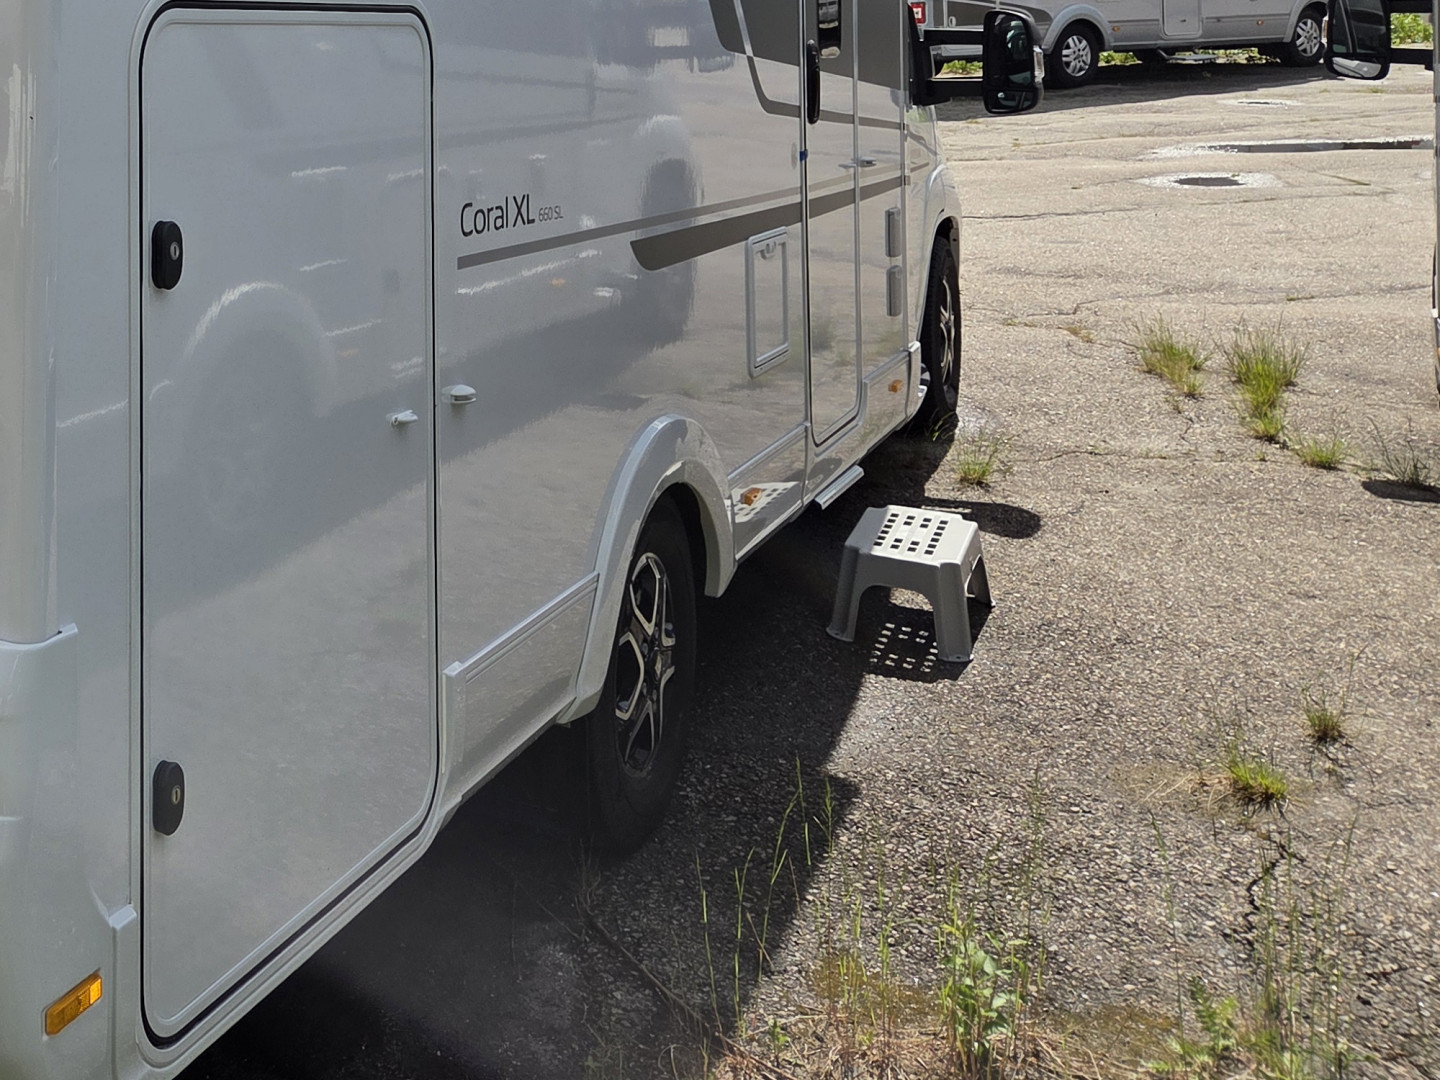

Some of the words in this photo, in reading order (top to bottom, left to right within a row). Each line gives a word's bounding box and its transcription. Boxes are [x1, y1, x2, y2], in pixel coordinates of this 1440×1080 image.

[460, 195, 509, 238] Coral
[513, 193, 536, 228] XL
[538, 206, 553, 222] 660
[554, 205, 564, 219] SL
